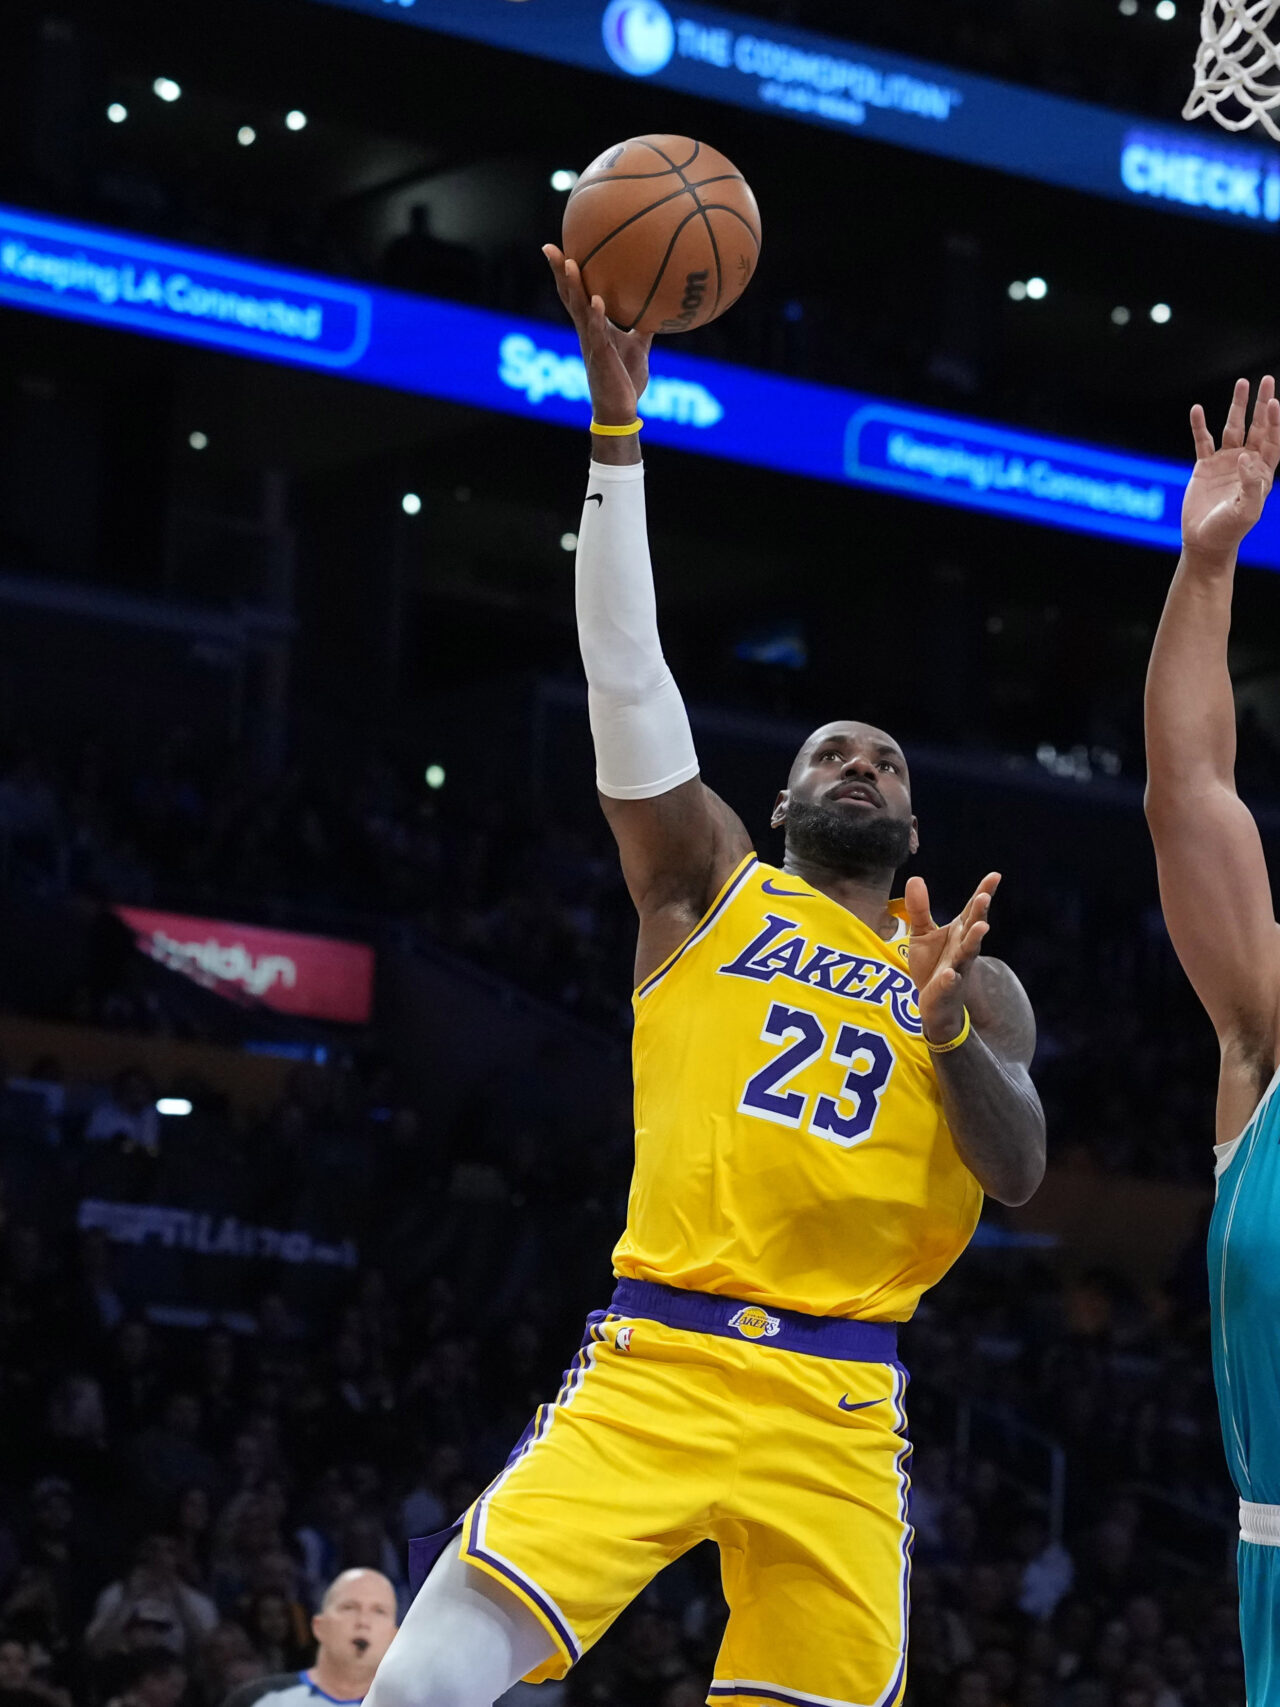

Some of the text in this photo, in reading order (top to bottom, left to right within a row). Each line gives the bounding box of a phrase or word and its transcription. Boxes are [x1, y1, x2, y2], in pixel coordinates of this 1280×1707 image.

[677, 18, 731, 68] THE
[1120, 140, 1262, 218] CHECK
[2, 240, 323, 341] Keeping LA Connected
[886, 430, 1165, 522] Keeping LA Connected
[737, 1000, 897, 1148] 23
[730, 1310, 780, 1336] LAKERS
